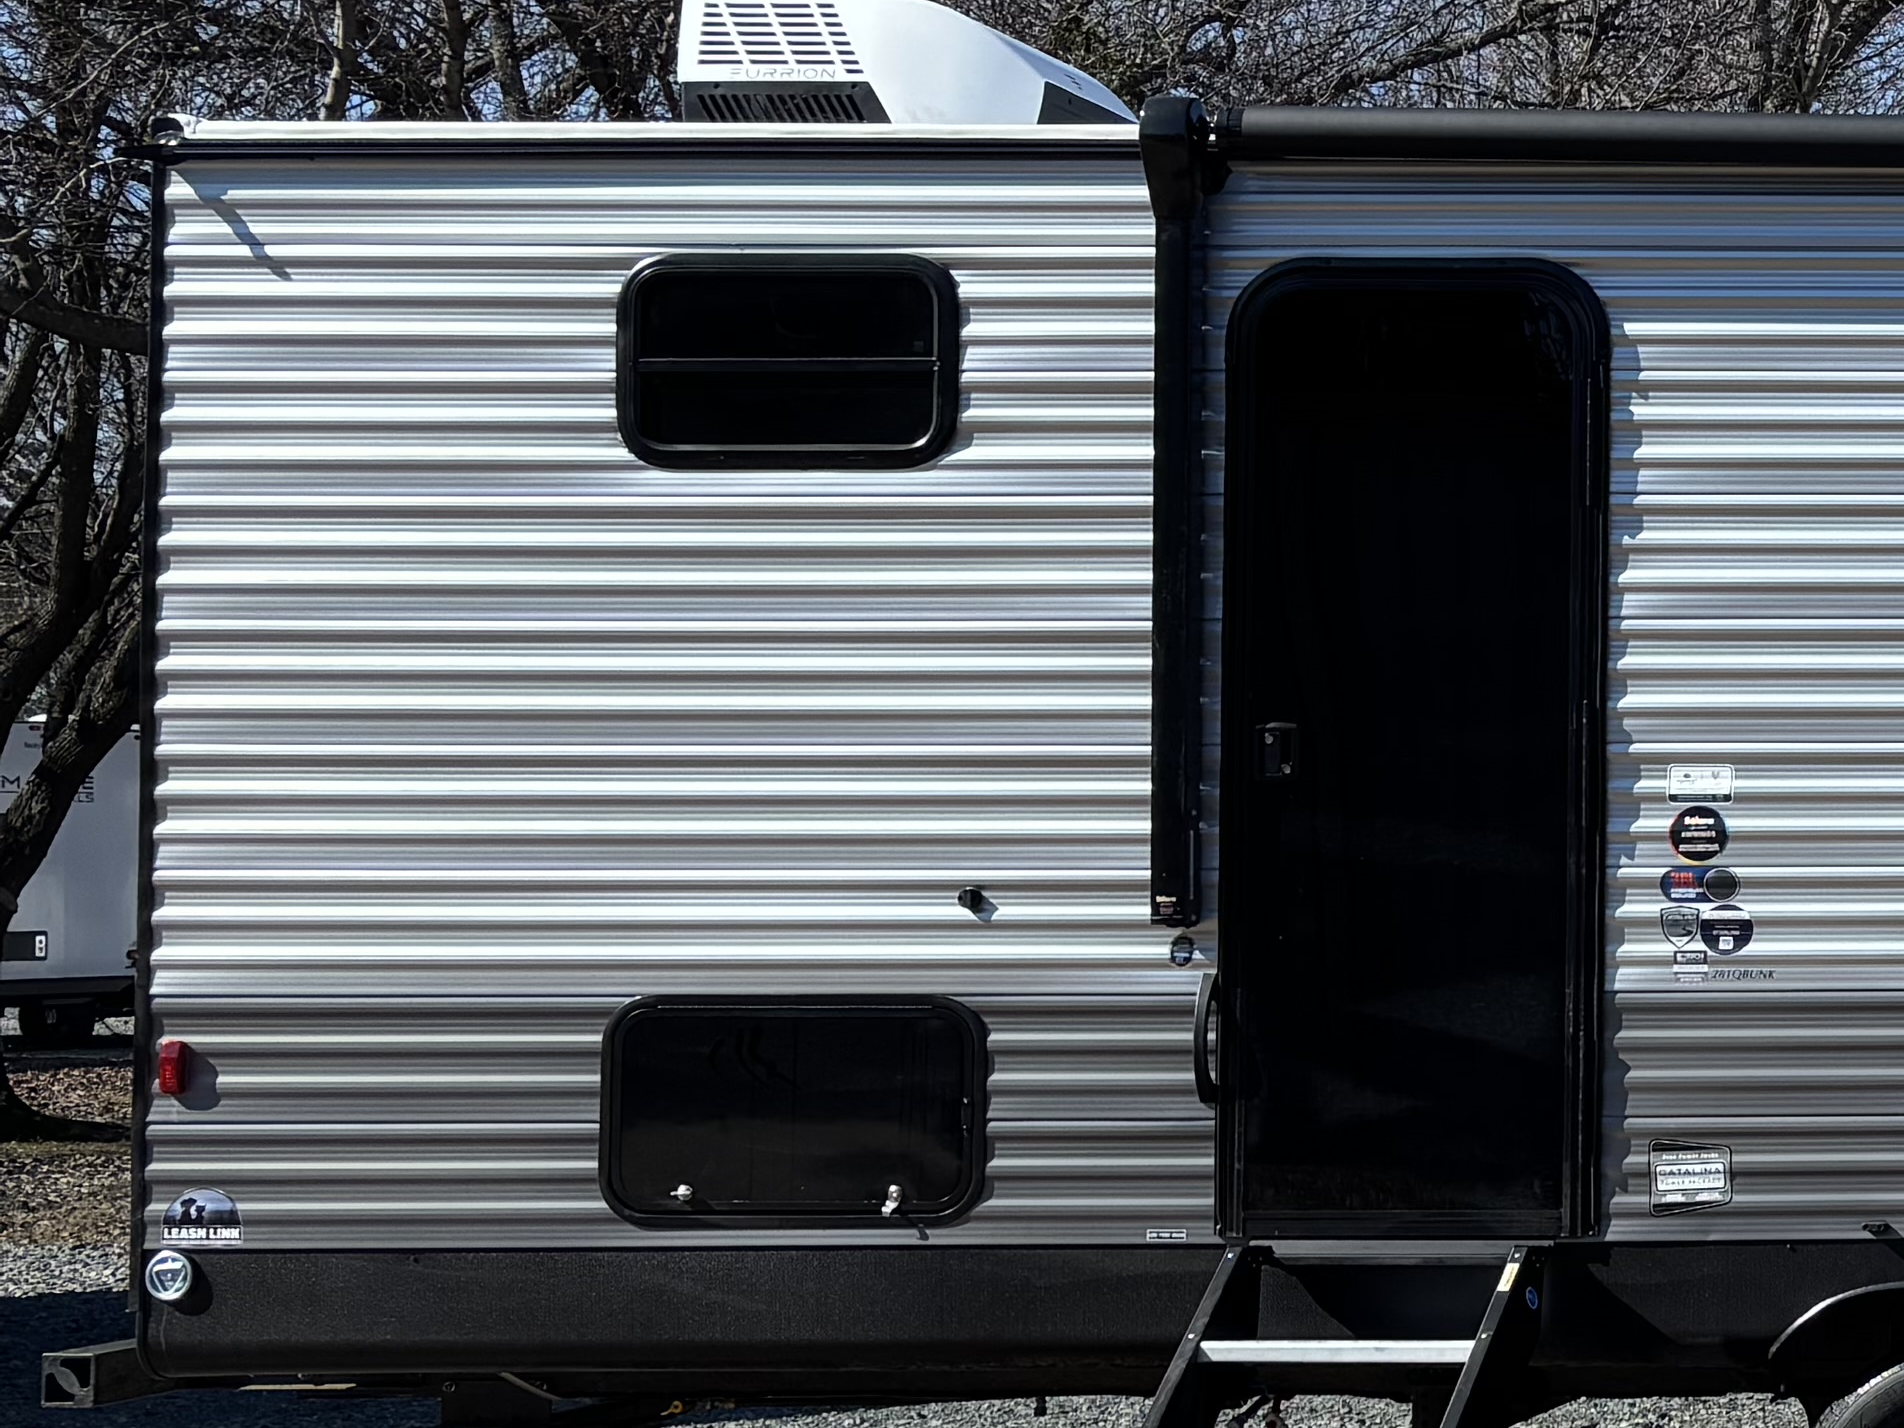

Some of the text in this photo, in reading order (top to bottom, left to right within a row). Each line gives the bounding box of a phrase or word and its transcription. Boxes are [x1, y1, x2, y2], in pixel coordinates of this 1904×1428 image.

[728, 67, 836, 80] FURRION
[1658, 1167, 1722, 1176] CATALINA
[163, 1227, 241, 1240] LEASH LINK
